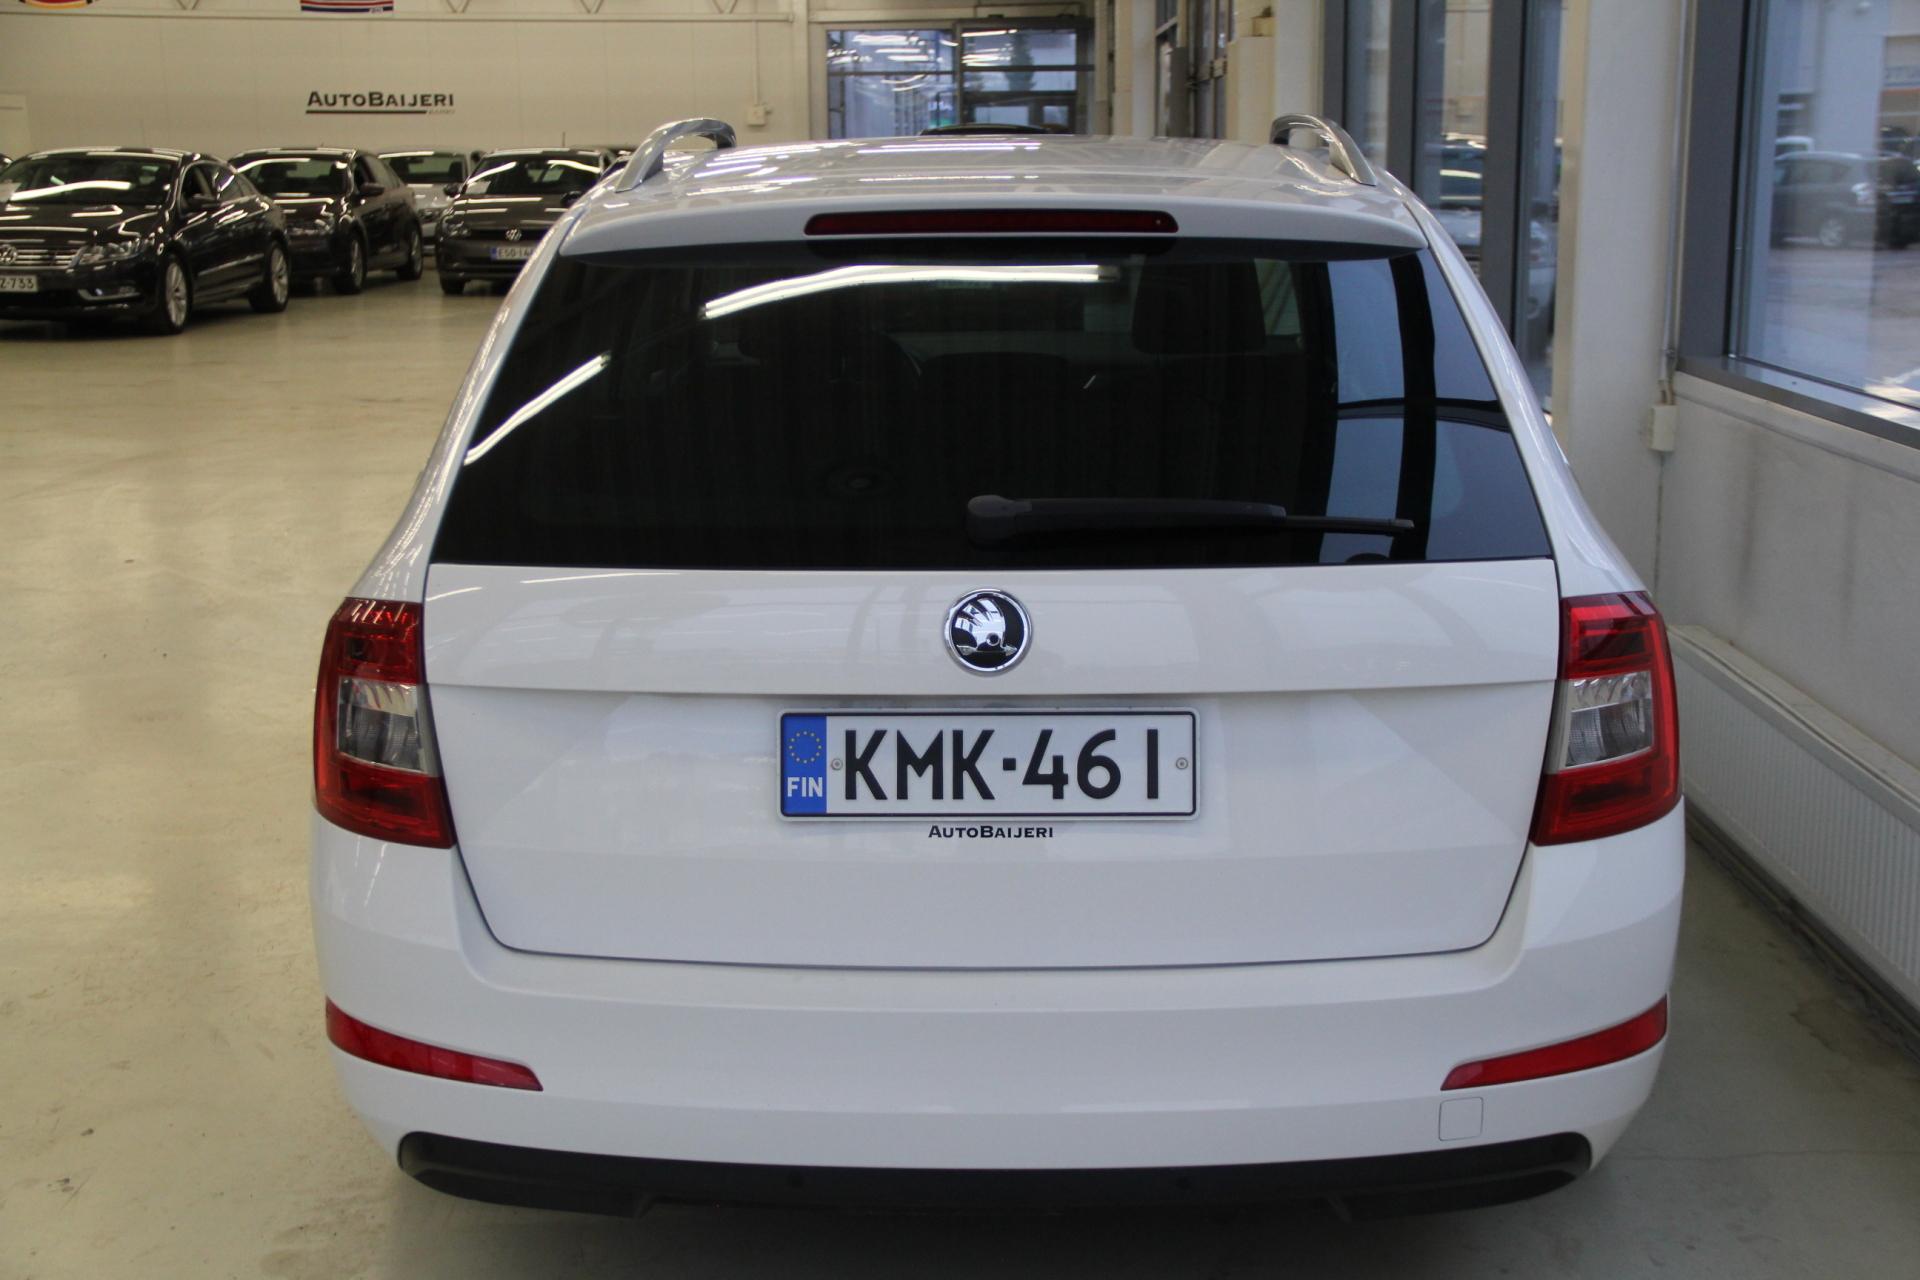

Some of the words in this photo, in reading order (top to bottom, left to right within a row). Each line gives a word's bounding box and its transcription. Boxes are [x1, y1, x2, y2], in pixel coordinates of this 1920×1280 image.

[307, 91, 454, 106] AUTOBAIJERI
[845, 728, 1159, 800] KMK-461
[786, 776, 823, 798] FIN
[928, 825, 1054, 839] AUTOBAIJERI
